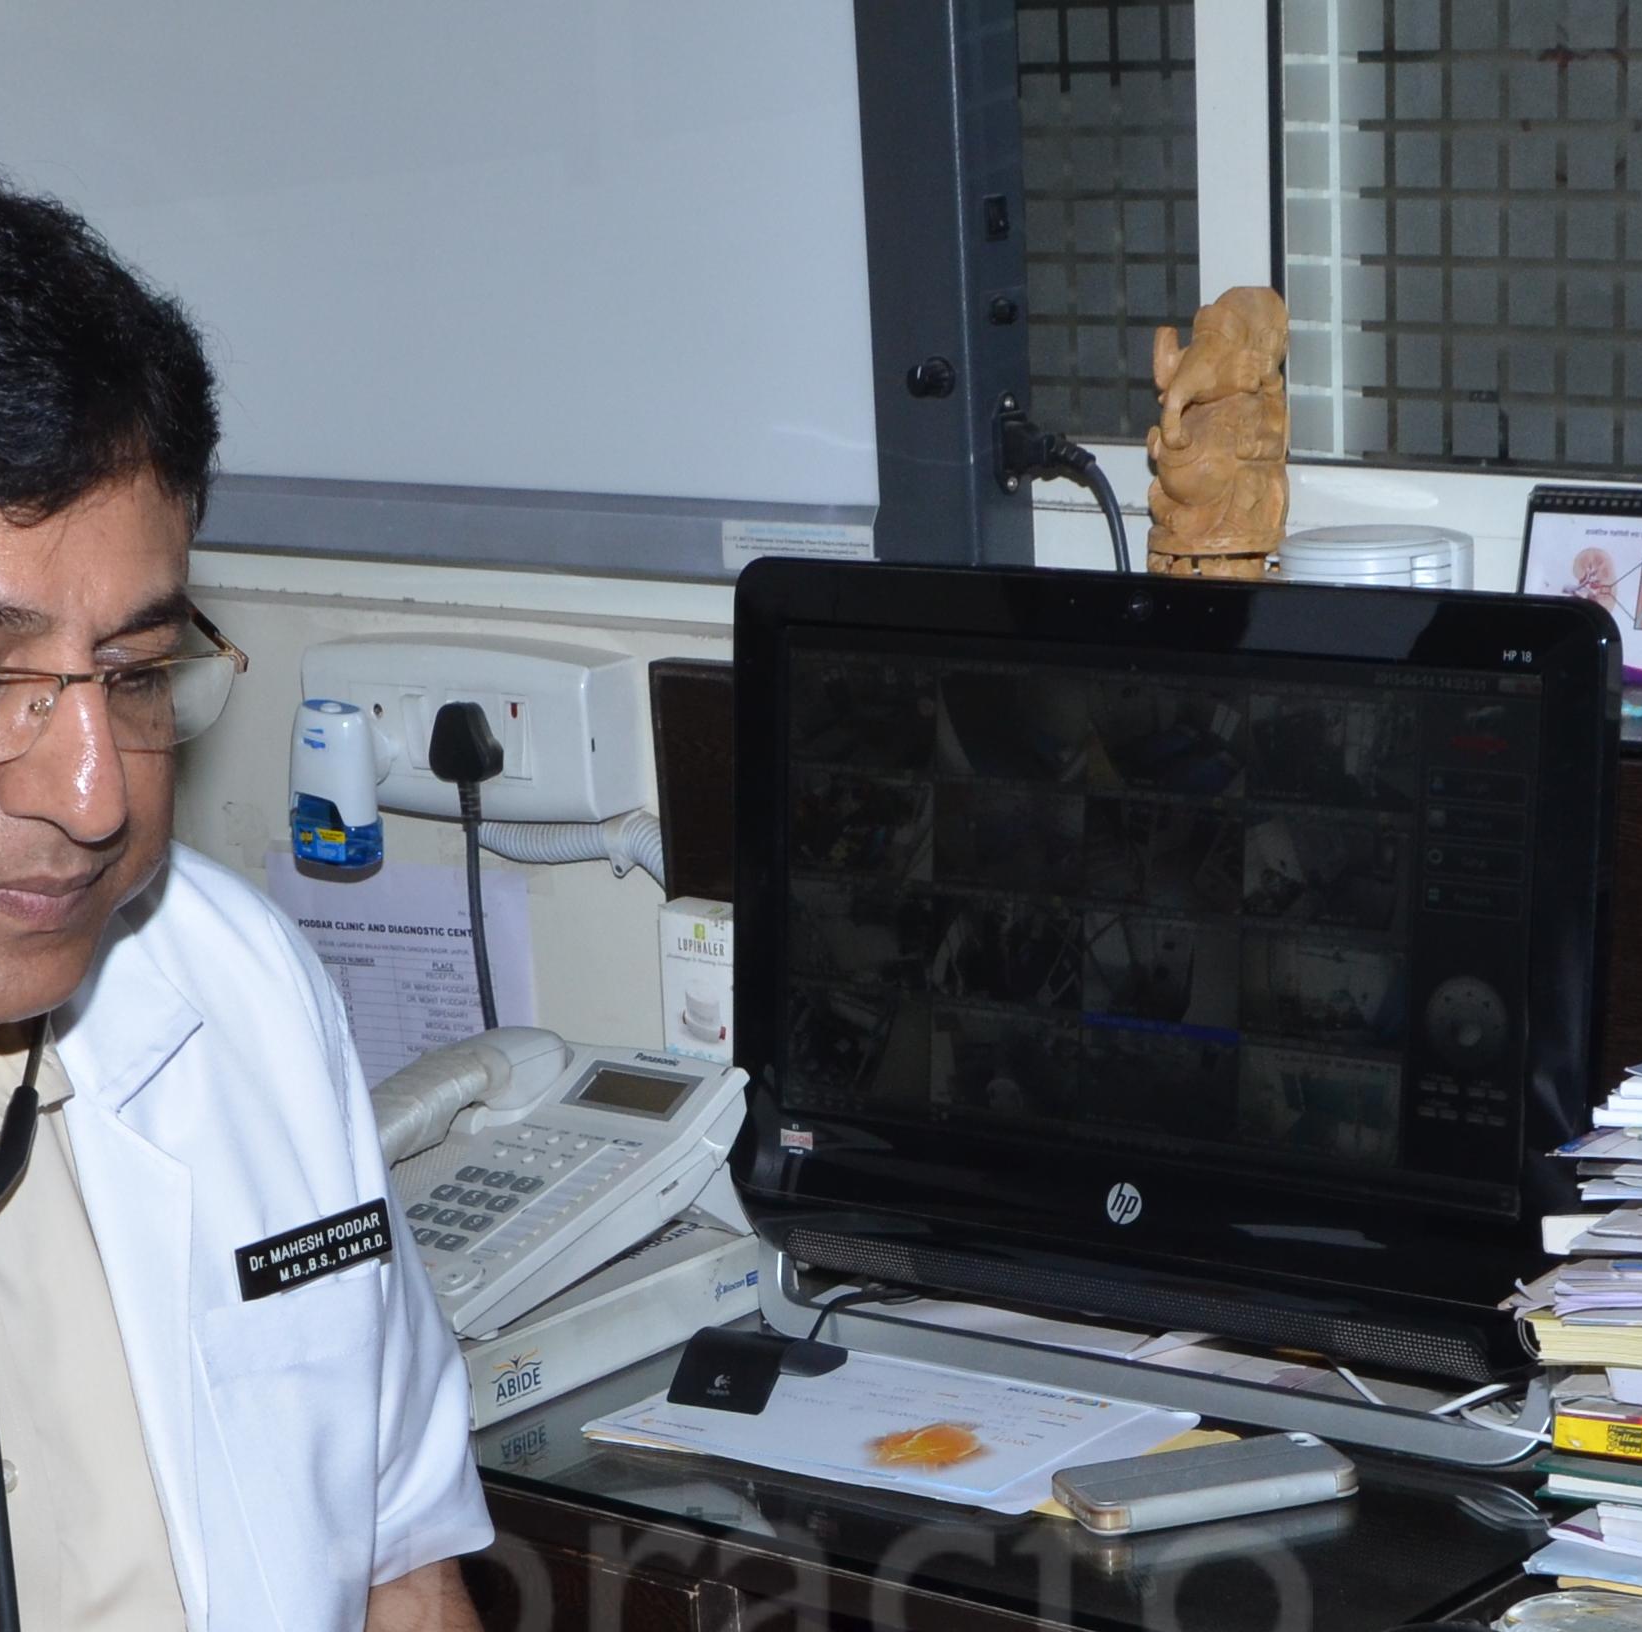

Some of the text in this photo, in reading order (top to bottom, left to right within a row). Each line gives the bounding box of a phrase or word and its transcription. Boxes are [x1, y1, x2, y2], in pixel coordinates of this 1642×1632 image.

[1502, 649, 1533, 663] HP 18
[298, 918, 445, 937] PODDAR CLINIC AND DIAGNOSTIC
[431, 961, 455, 972] PLACE
[633, 1051, 681, 1068] Panasonic
[1111, 1184, 1140, 1224] hp
[248, 1211, 381, 1273] Dr. MAHESH PODDAR
[338, 1233, 388, 1261] D.M.R.D.
[495, 1366, 543, 1403] ABIDE
